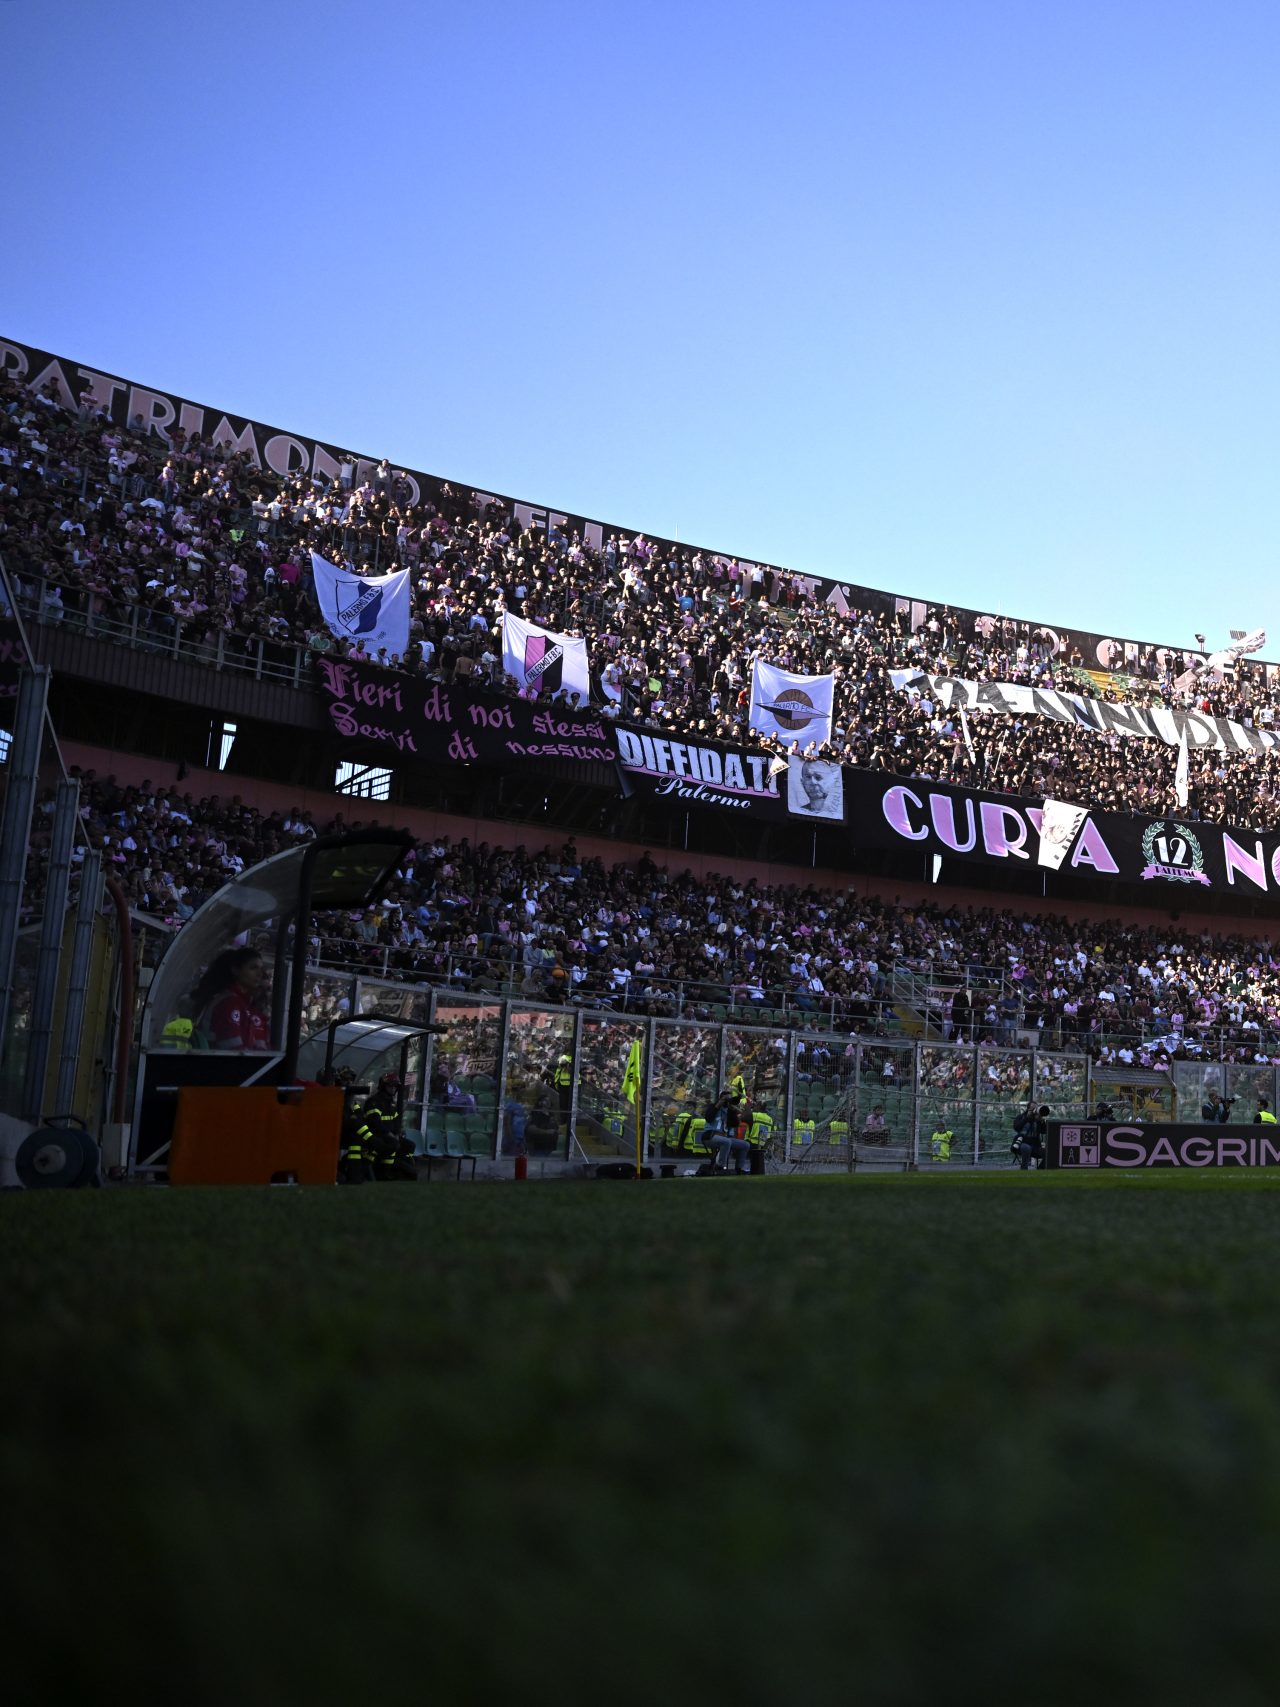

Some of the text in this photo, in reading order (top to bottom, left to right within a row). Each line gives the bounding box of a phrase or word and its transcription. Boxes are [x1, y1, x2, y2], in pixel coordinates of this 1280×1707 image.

[527, 656, 551, 681] PALERMO
[316, 658, 607, 741] Fieri di noi stessi
[1032, 687, 1170, 744] ANNI
[1171, 709, 1240, 753] DI
[448, 729, 479, 760] di
[505, 740, 616, 761] nessuno
[615, 727, 780, 794] DIFFIDATI
[654, 775, 751, 809] Palermo
[1154, 836, 1188, 866] 12
